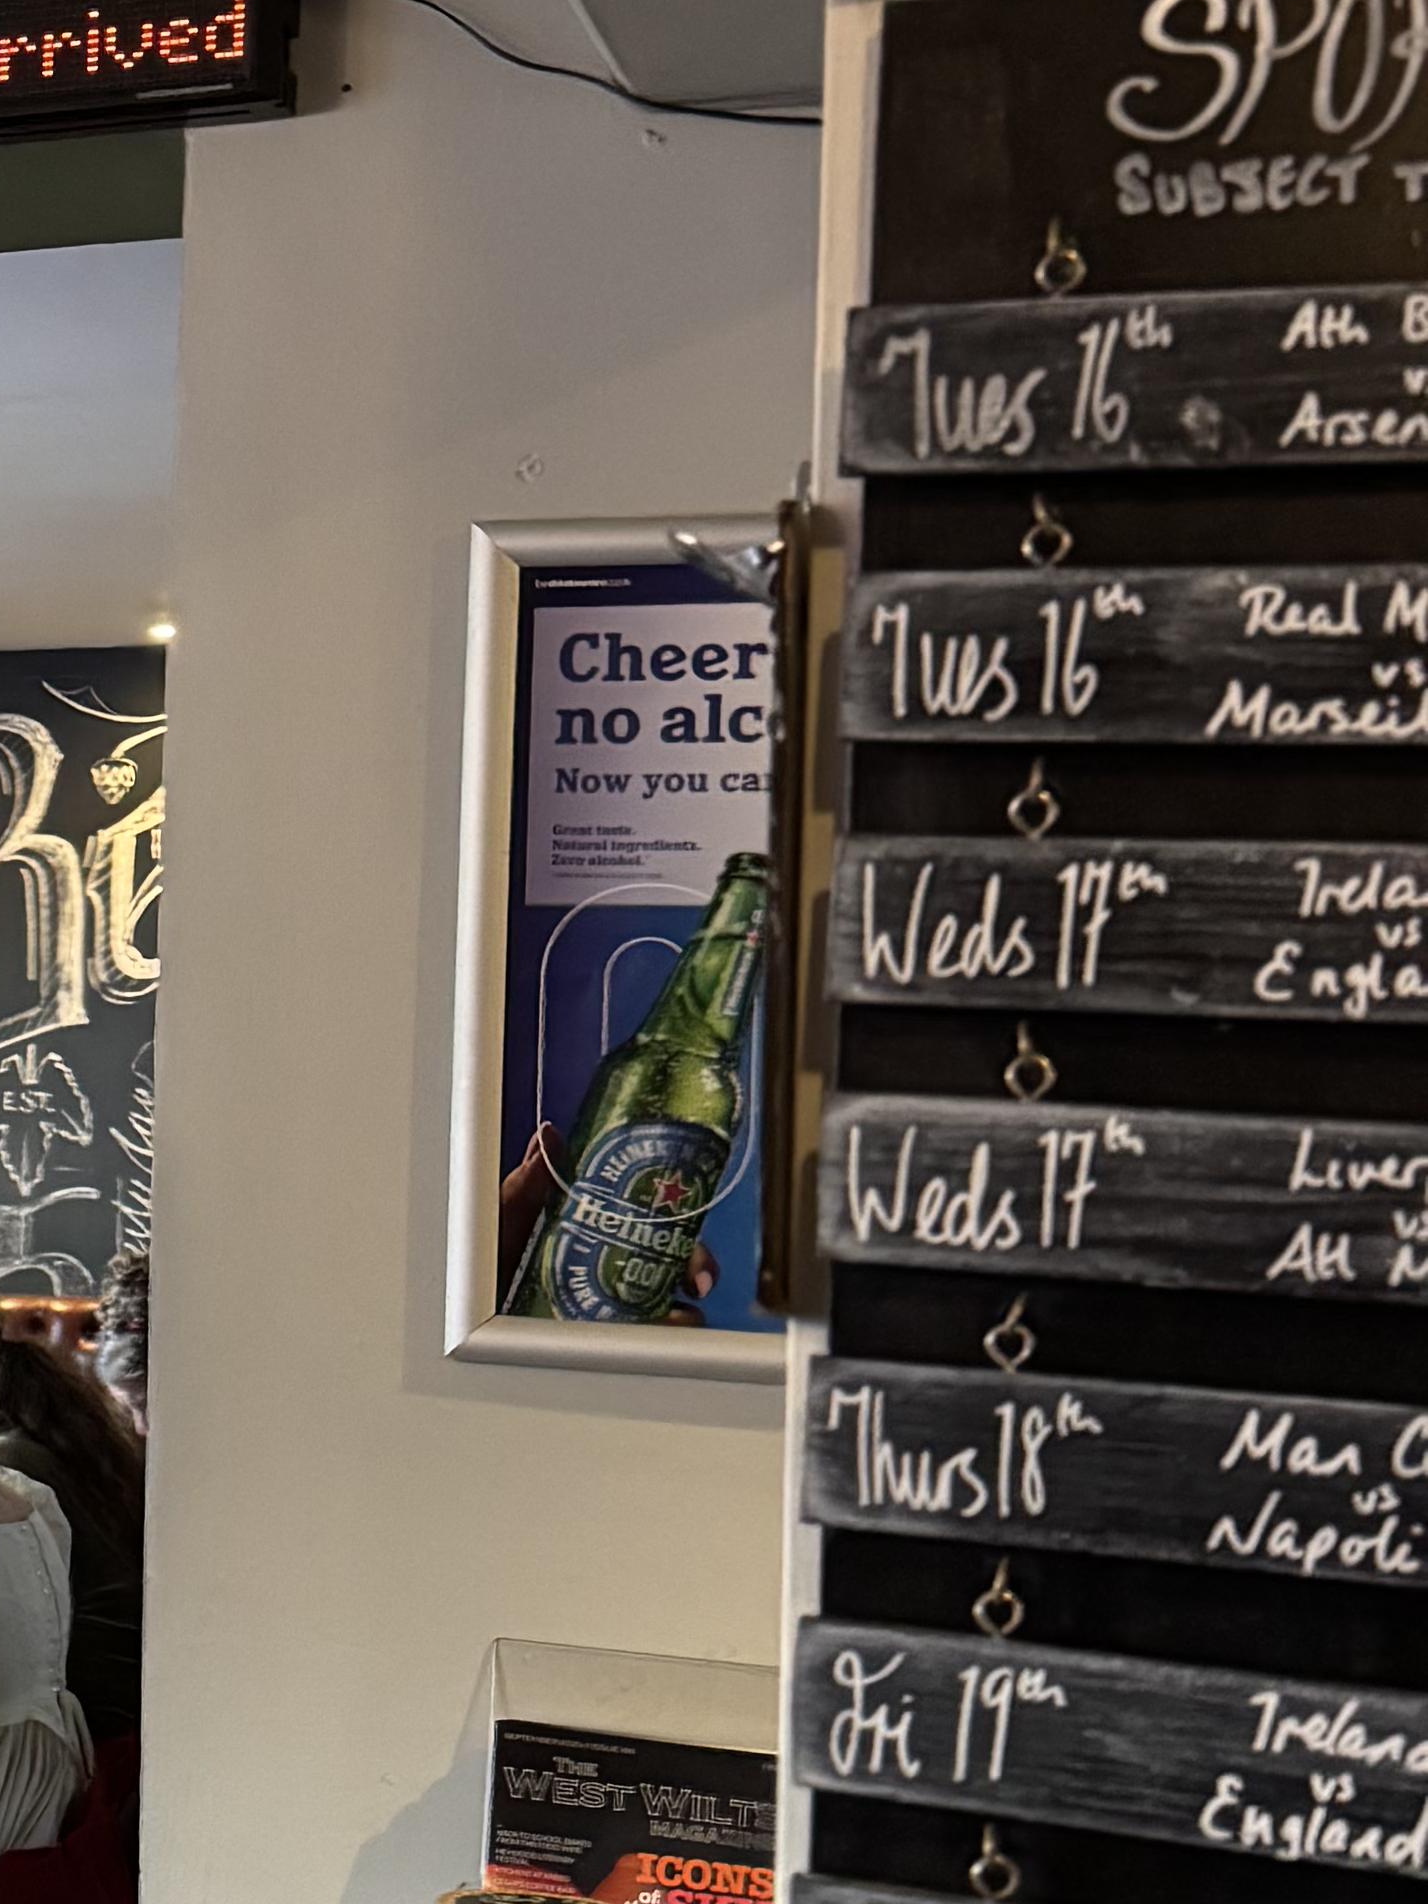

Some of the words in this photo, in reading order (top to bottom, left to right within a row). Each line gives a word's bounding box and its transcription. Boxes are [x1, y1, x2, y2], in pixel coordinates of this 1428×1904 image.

[1114, 152, 1370, 217] SUBJECT
[1239, 579, 1362, 637] Real
[558, 632, 768, 683] Cheer
[1371, 658, 1426, 689] vs
[554, 707, 641, 745] no
[554, 767, 632, 794] Now
[641, 772, 709, 799] you
[552, 824, 593, 836] Great
[552, 839, 608, 851] Natural
[610, 839, 703, 853] ingredients.
[551, 853, 586, 866] Zero
[862, 861, 1035, 984] Weds
[1374, 916, 1422, 949] vs
[847, 1124, 1022, 1250] Weds
[1289, 1127, 1428, 1204] Liver
[827, 1385, 989, 1517] Thurs
[1219, 1407, 1363, 1476] Man
[1351, 1482, 1401, 1516] vs
[1206, 1489, 1422, 1578] Napoli
[828, 1649, 921, 1778] Fri
[952, 1665, 1068, 1783] 19th
[503, 1766, 637, 1812] WEST
[552, 1755, 599, 1777] THE
[1308, 1771, 1356, 1804] vs
[1198, 1772, 1428, 1871] England
[636, 1852, 775, 1899] ICONS
